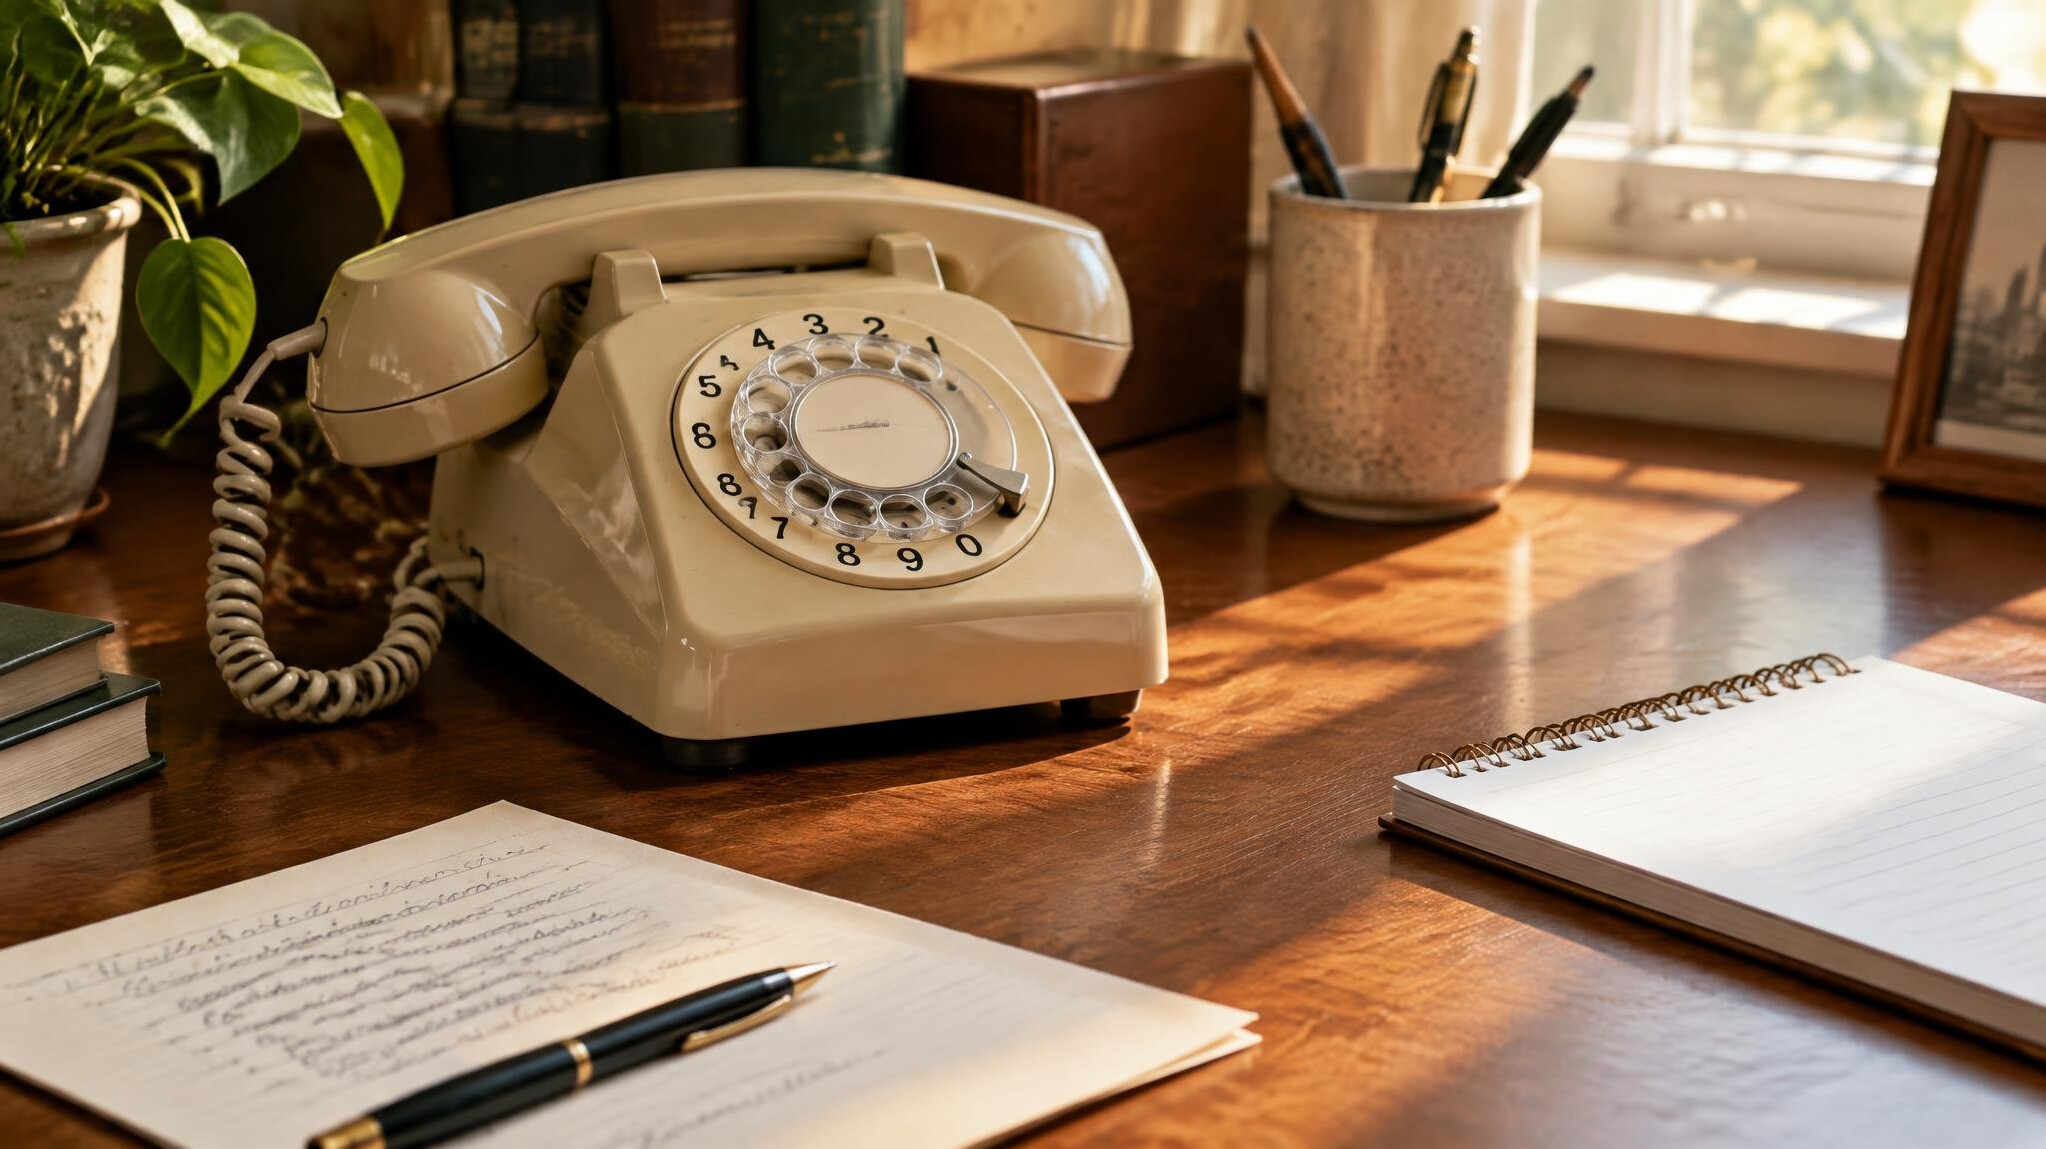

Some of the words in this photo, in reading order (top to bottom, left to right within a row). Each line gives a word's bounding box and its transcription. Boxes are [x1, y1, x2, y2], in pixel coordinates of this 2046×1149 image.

[802, 313, 828, 335] 3
[863, 316, 889, 339] 2
[752, 327, 775, 350] 4
[926, 336, 941, 357] 1
[698, 374, 721, 397] 5
[717, 473, 742, 497] 8
[770, 516, 789, 540] 7
[835, 542, 860, 567] 8
[896, 547, 923, 572] 9
